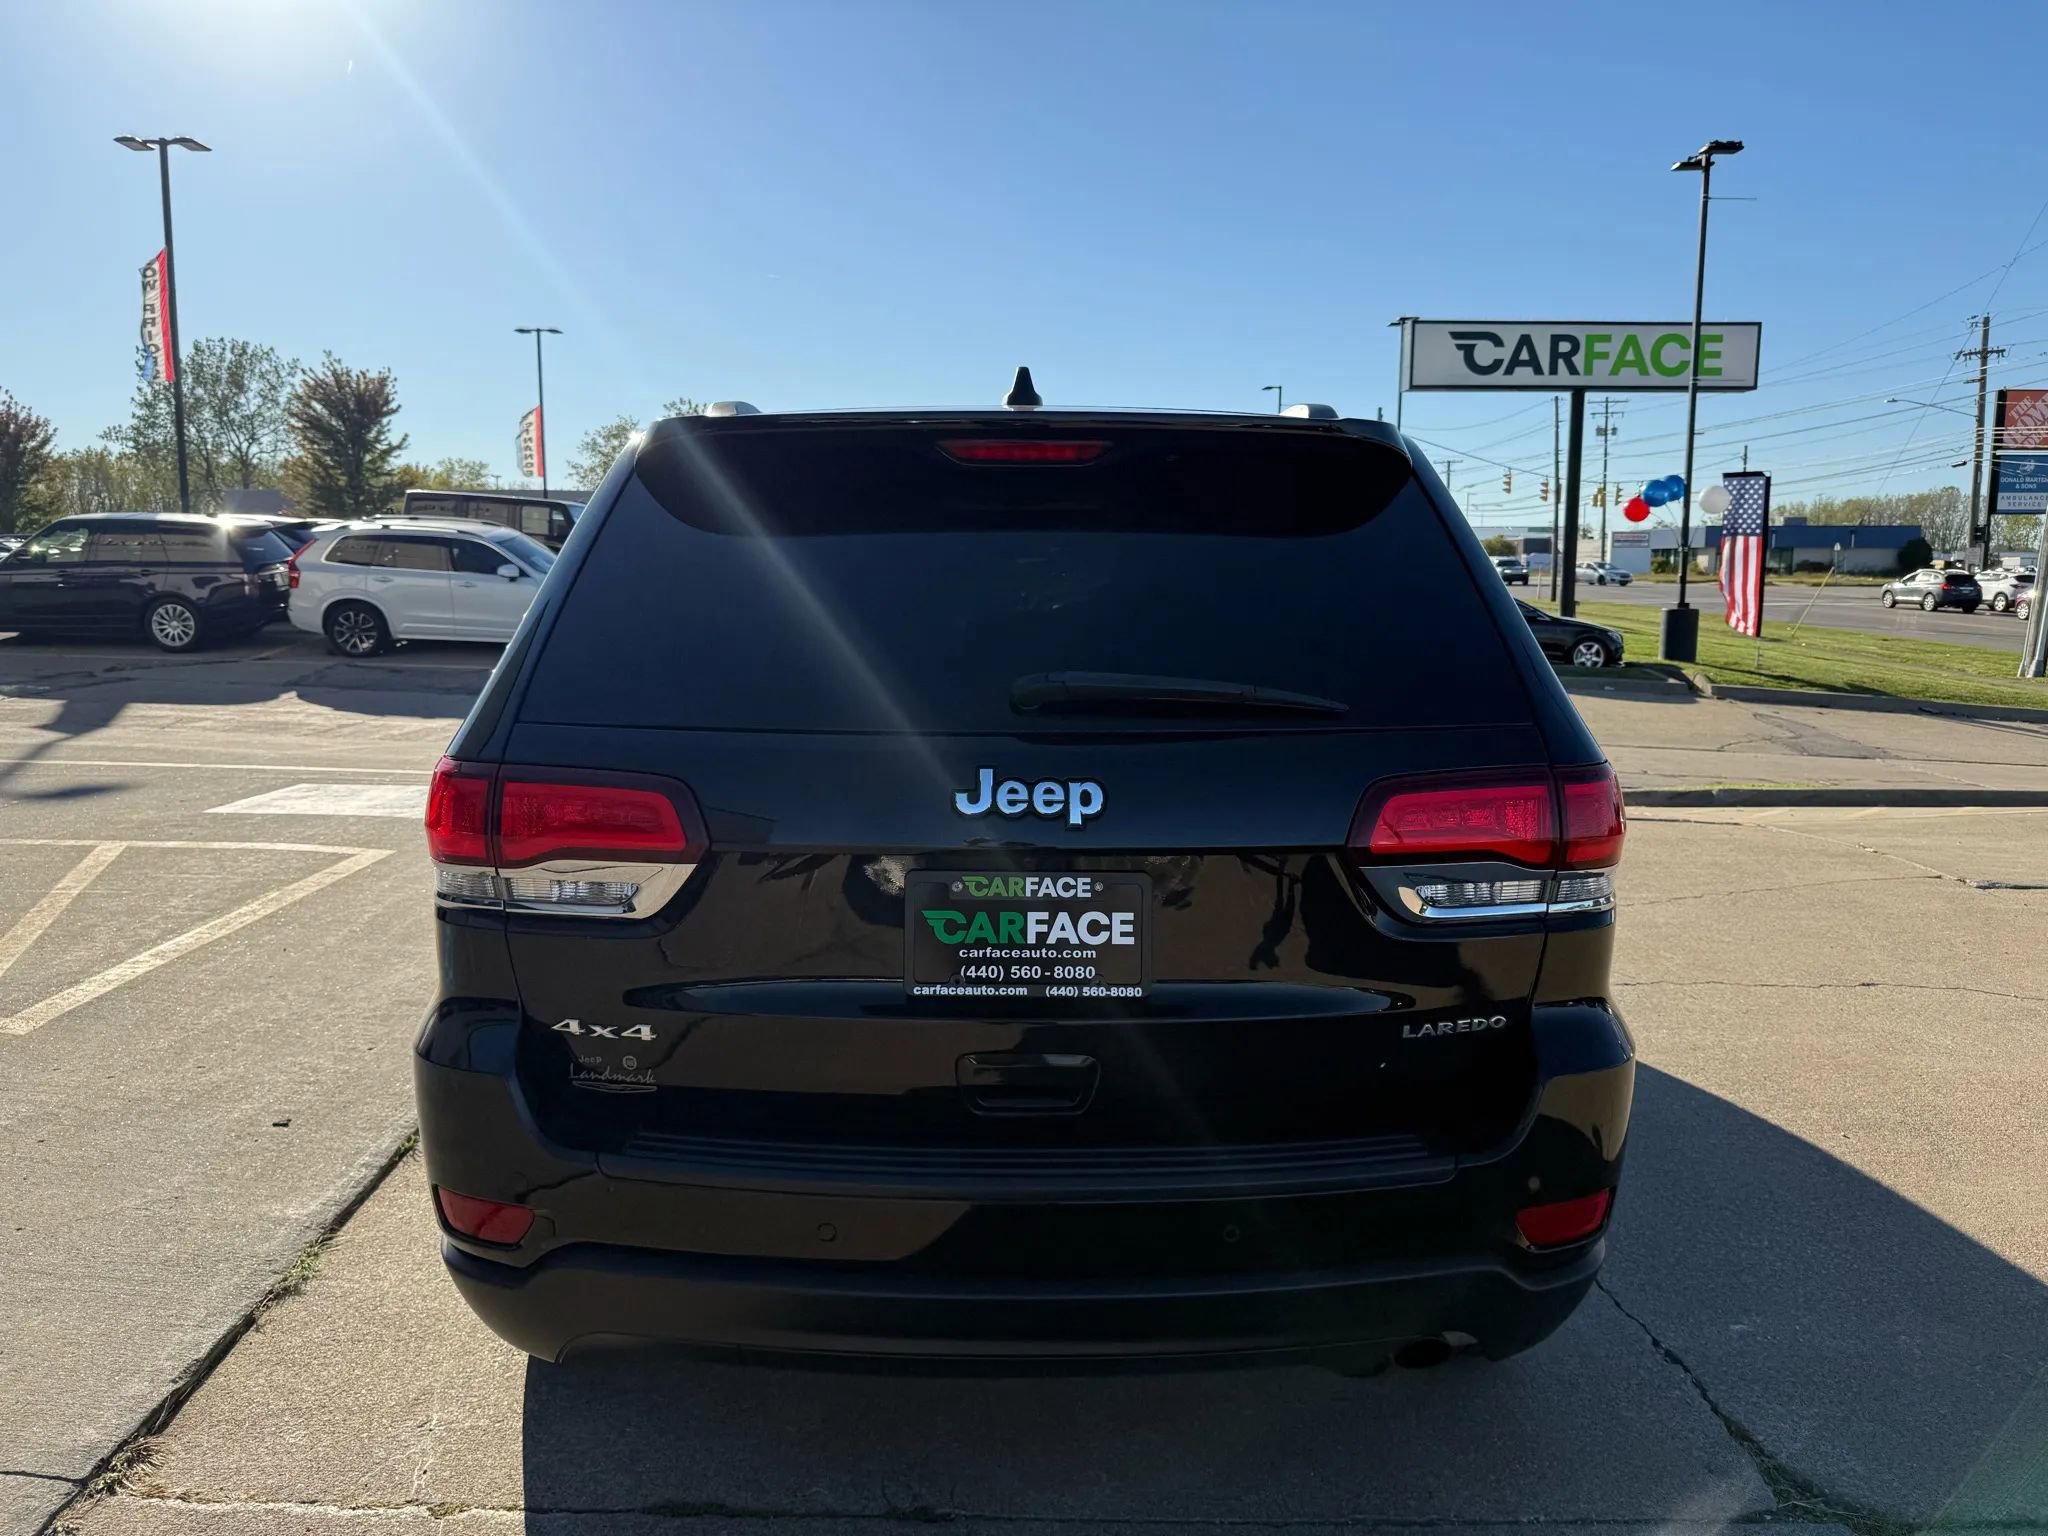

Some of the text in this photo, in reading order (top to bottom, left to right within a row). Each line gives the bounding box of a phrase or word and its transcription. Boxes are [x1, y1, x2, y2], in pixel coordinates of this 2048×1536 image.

[1448, 331, 1724, 378] CARFACE
[955, 768, 1104, 825] Jeep
[961, 876, 1091, 897] CARFACE
[921, 910, 1135, 945] CARFACE
[959, 947, 1097, 959] carfaceauto.com
[960, 965, 1004, 982] (440)
[913, 984, 1142, 998] carfaceauto.com (440) 560-8080
[551, 1018, 657, 1041] 4x4
[1402, 1015, 1507, 1038] LAREDO
[568, 1062, 657, 1084] Landmark
